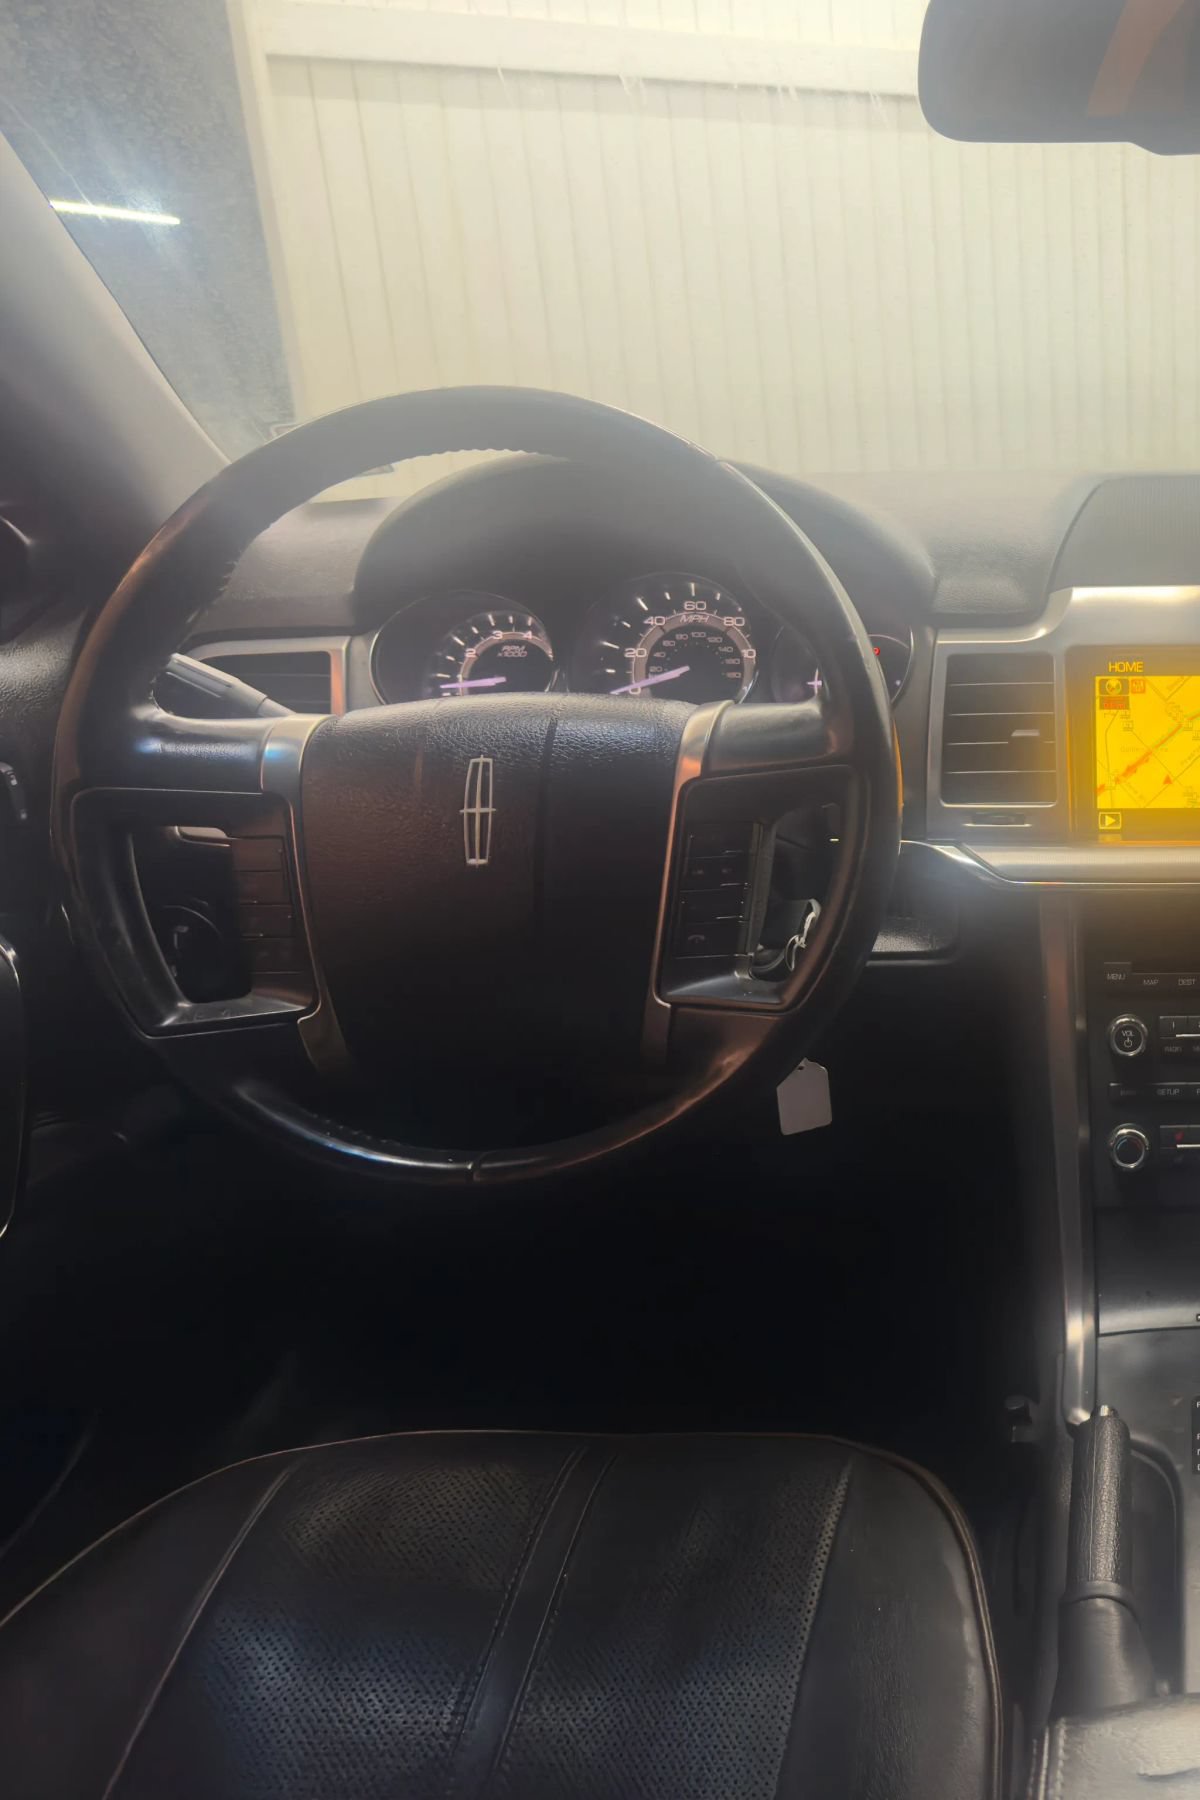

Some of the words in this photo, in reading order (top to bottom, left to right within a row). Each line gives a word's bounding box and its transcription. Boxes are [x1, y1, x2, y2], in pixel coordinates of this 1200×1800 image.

[684, 601, 706, 611] 60
[643, 616, 666, 626] 40
[680, 615, 709, 623] MPH
[723, 617, 745, 626] 80
[492, 631, 503, 640] 3
[523, 631, 533, 640] 4
[465, 648, 476, 658] 2
[624, 648, 647, 658] 20
[1108, 662, 1143, 673] HOME
[1143, 978, 1159, 987] MAP
[1178, 978, 1196, 986] DEST
[1121, 1030, 1134, 1038] VOL
[1156, 1088, 1180, 1096] SETUP
